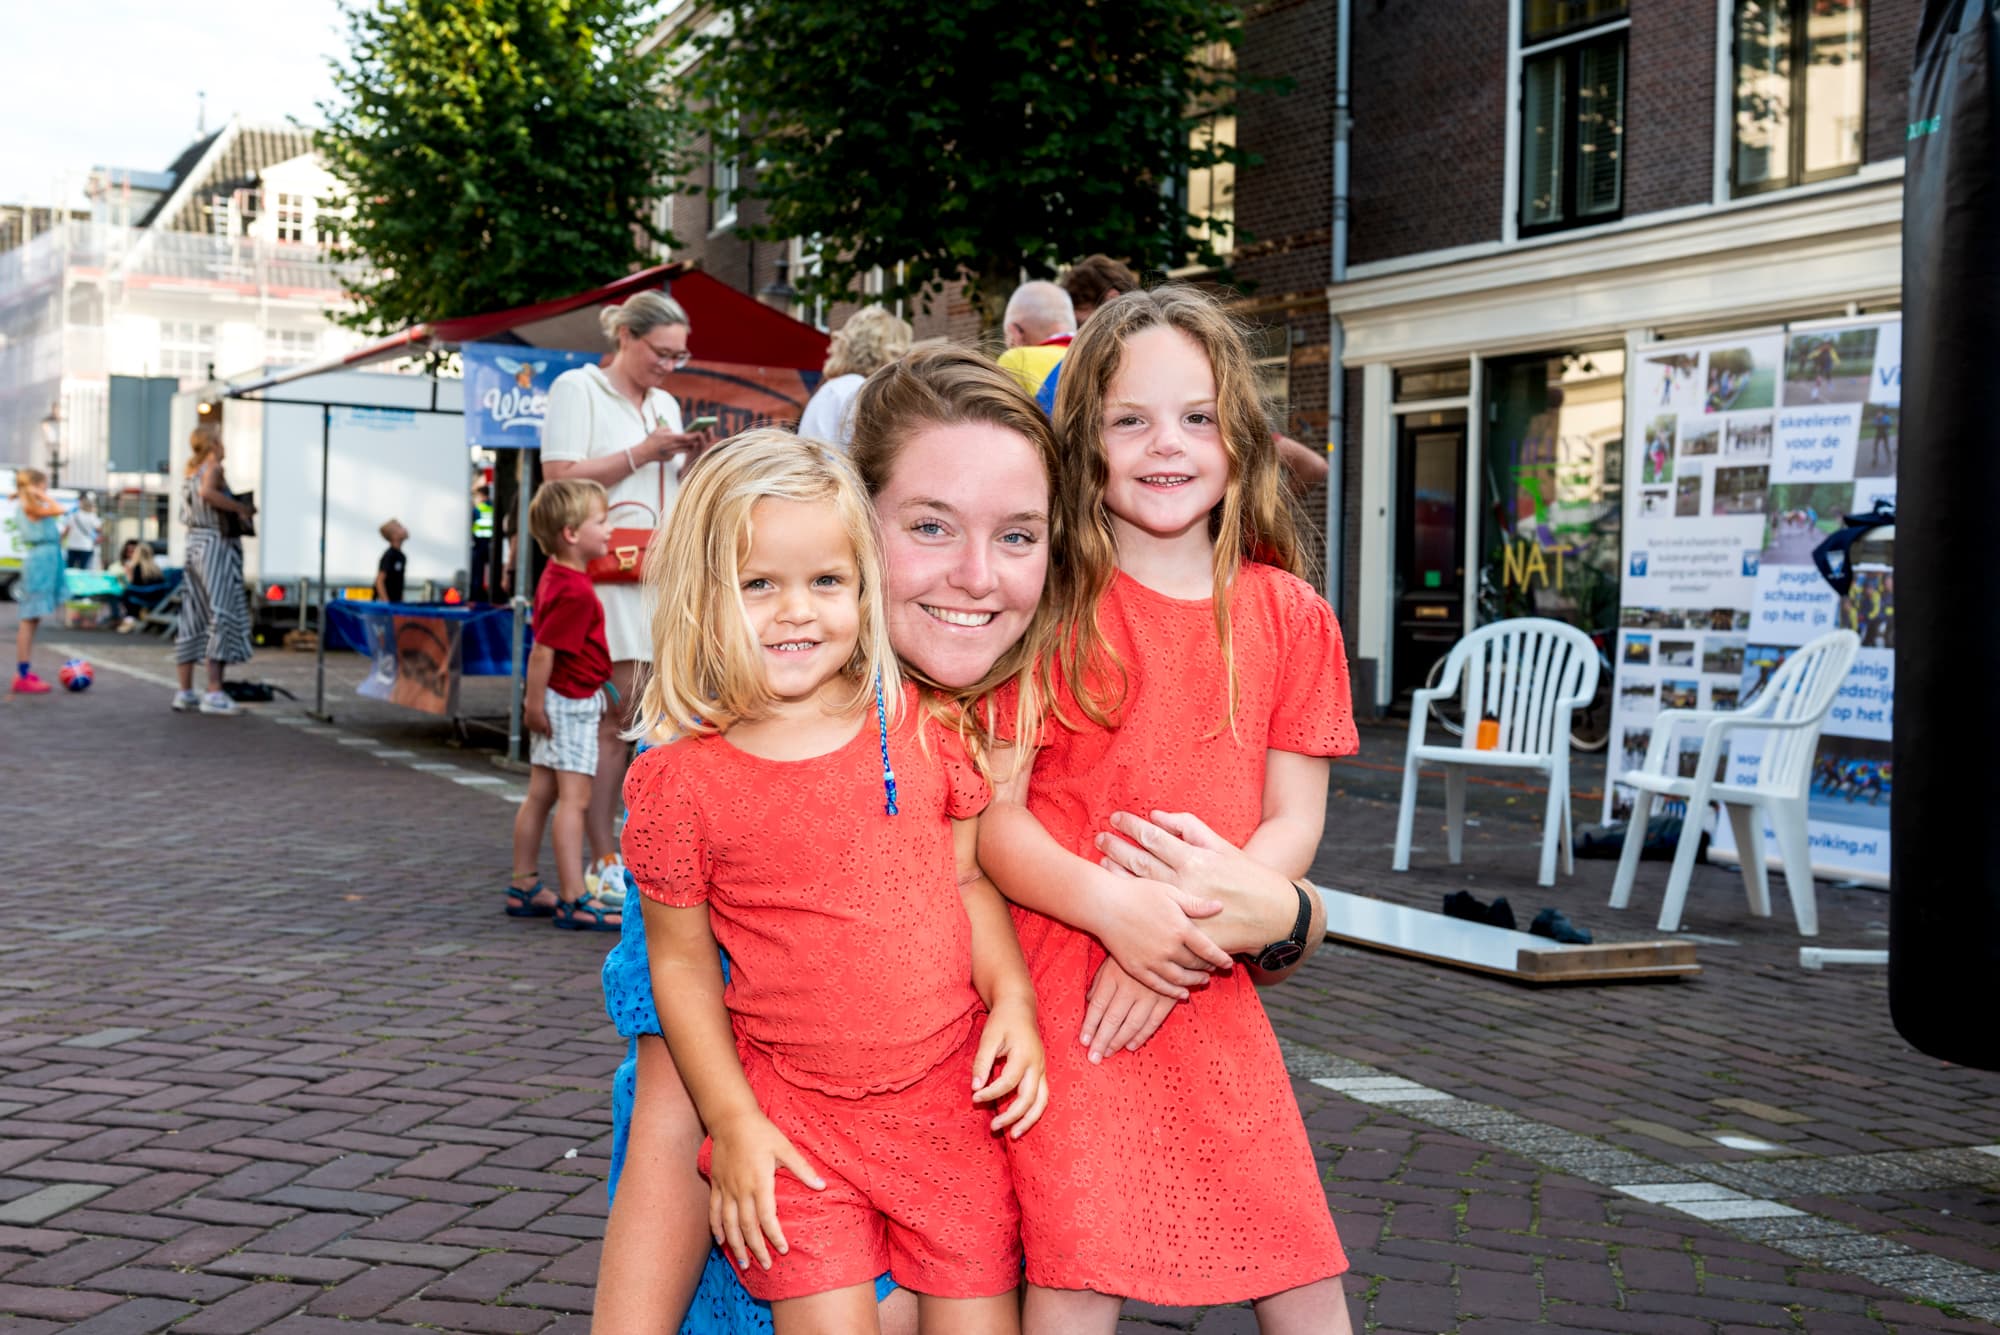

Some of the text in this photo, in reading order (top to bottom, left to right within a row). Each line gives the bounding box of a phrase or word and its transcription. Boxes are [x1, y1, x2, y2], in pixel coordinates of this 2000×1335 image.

[1780, 413, 1850, 428] skeeleren
[1785, 434, 1840, 449] voor de
[1788, 455, 1834, 474] jeugd
[1503, 541, 1573, 593] NAT
[1763, 590, 1833, 602] schaatsen
[1762, 608, 1828, 626] op het ijs
[1831, 706, 1852, 722] op
[1857, 706, 1883, 722] het
